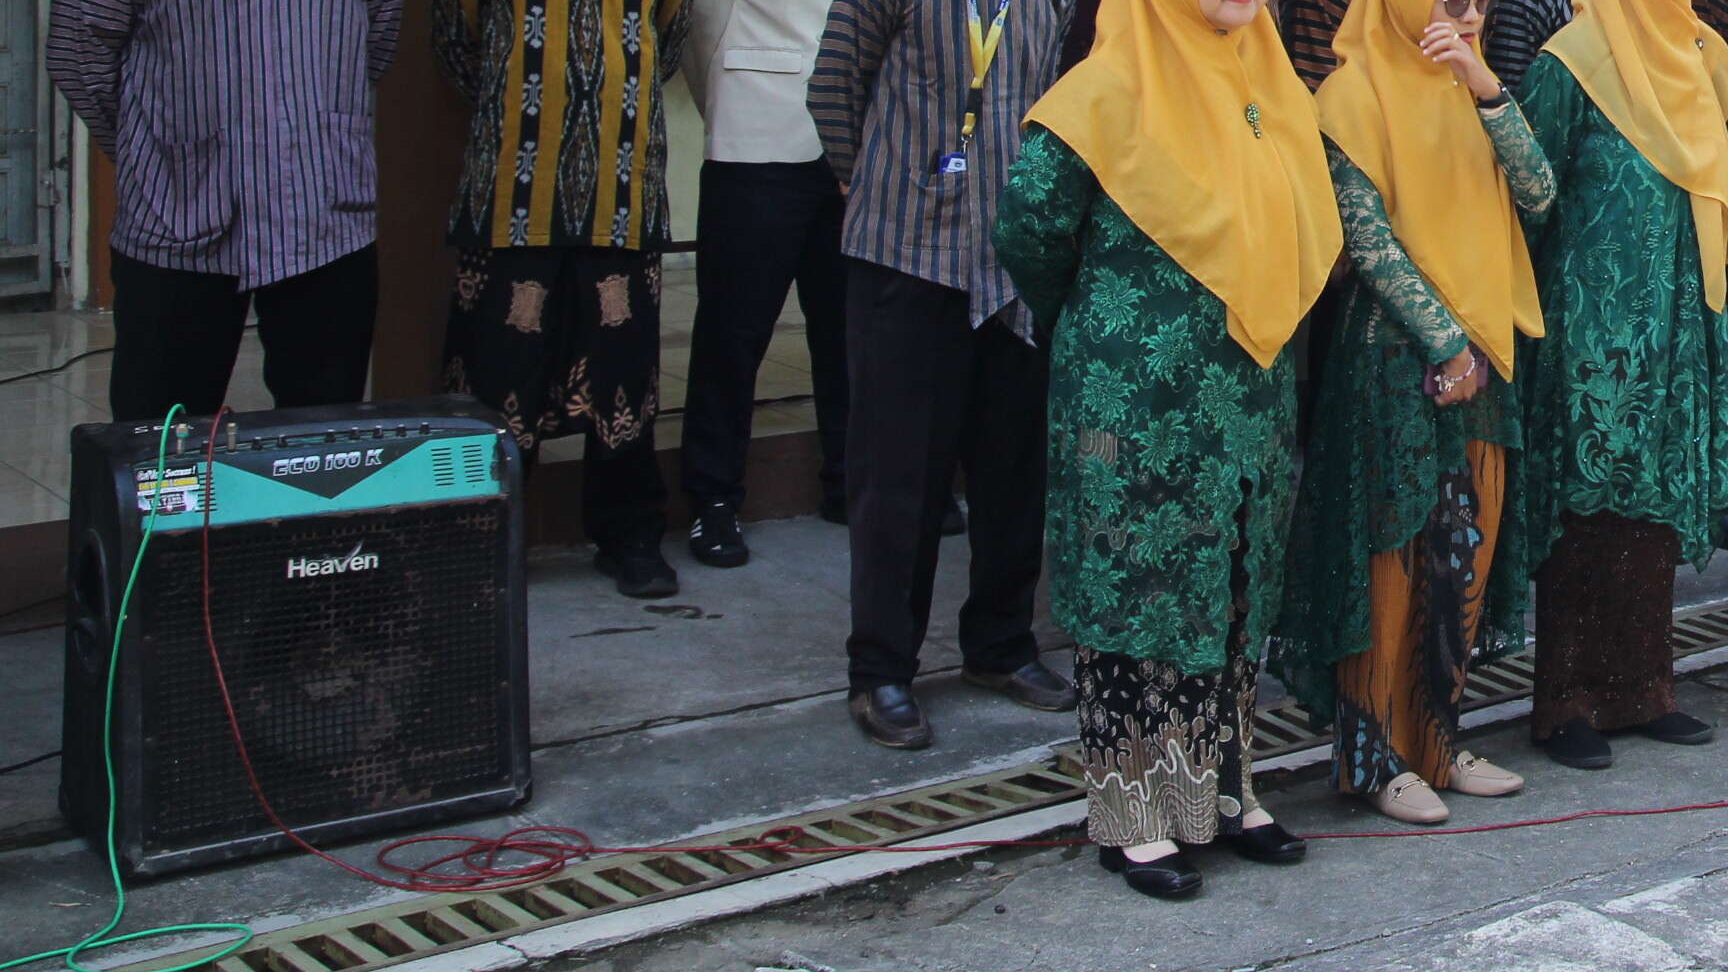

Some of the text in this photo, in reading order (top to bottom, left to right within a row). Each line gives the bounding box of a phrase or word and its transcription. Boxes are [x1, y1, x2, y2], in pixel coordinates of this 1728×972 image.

[273, 449, 384, 476] ECO 100 K
[287, 546, 379, 579] Heaven
